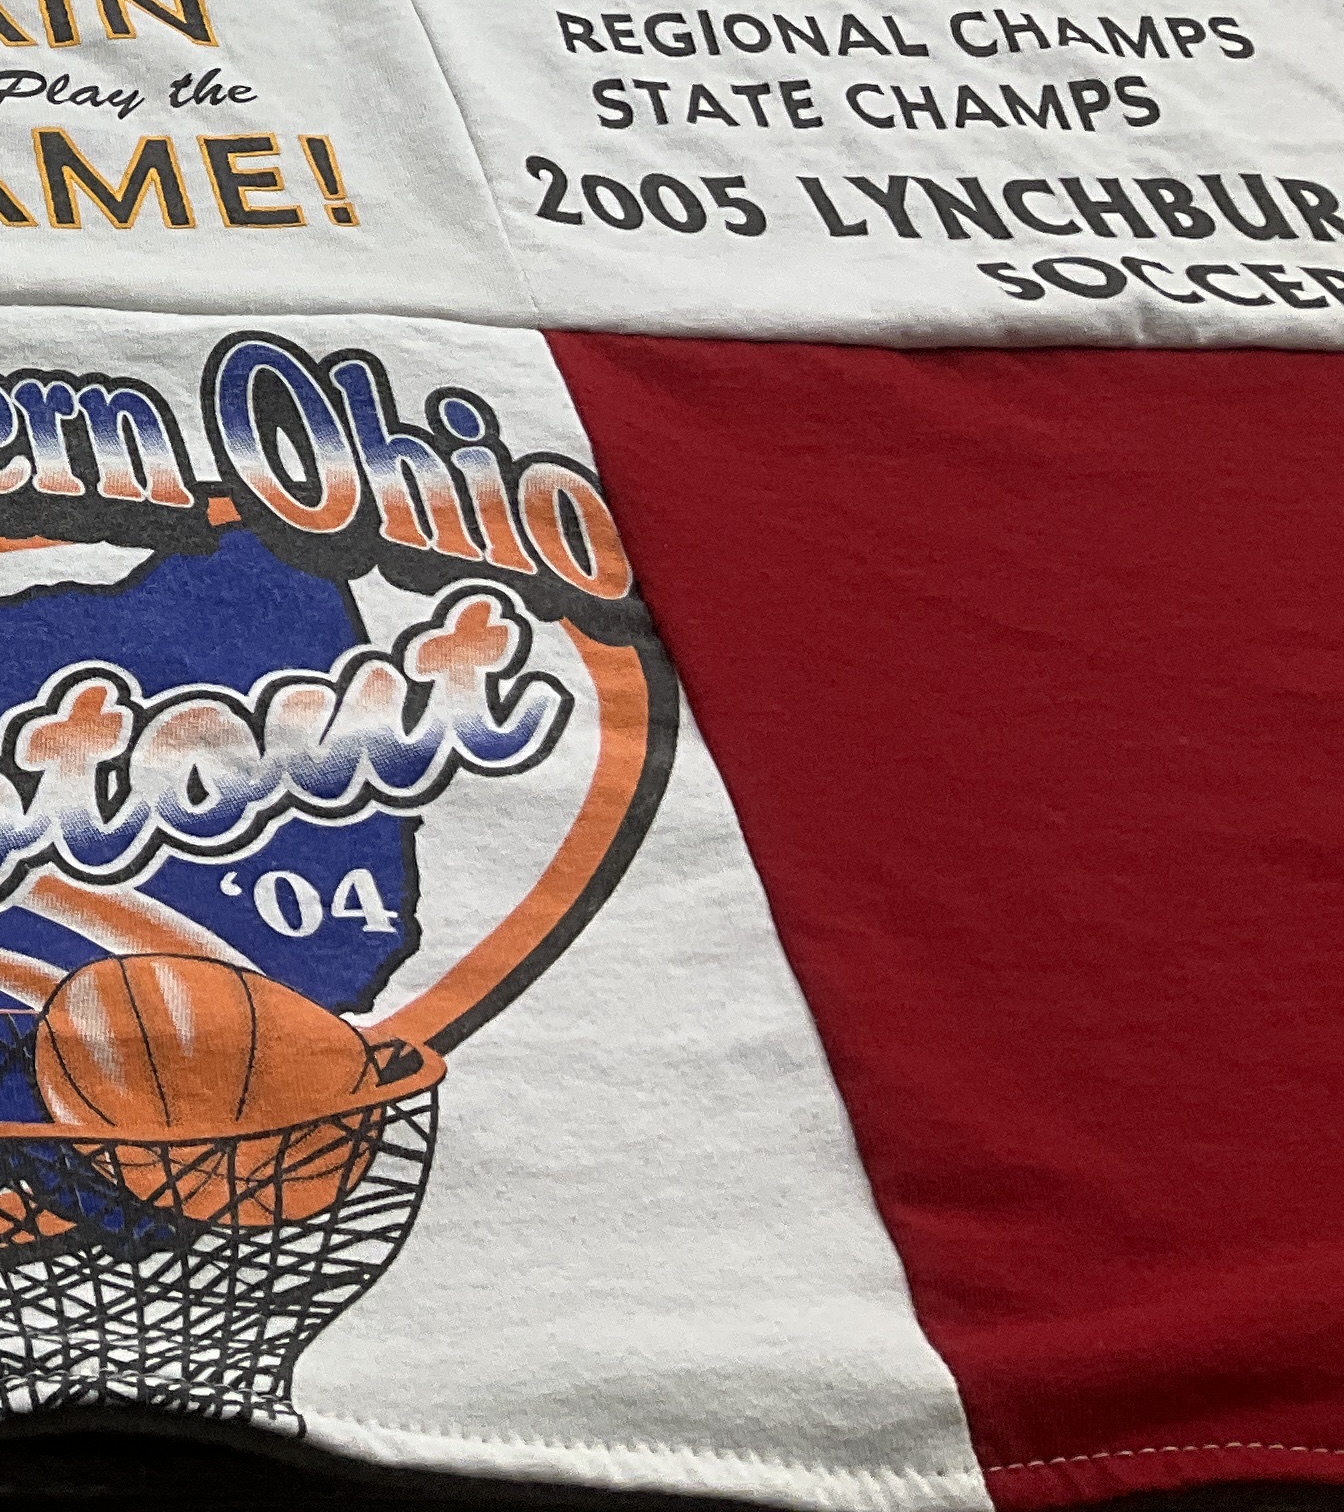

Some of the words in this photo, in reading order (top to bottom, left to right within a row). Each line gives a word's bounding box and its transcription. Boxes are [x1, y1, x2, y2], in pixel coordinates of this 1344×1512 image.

[555, 8, 930, 58] REGIONAL
[947, 9, 1255, 61] CHAMPS
[165, 70, 259, 110] the
[590, 78, 824, 131] STATE
[843, 75, 1162, 134] CHAMPS
[523, 154, 769, 238] 2005
[200, 330, 644, 604] Ohio
